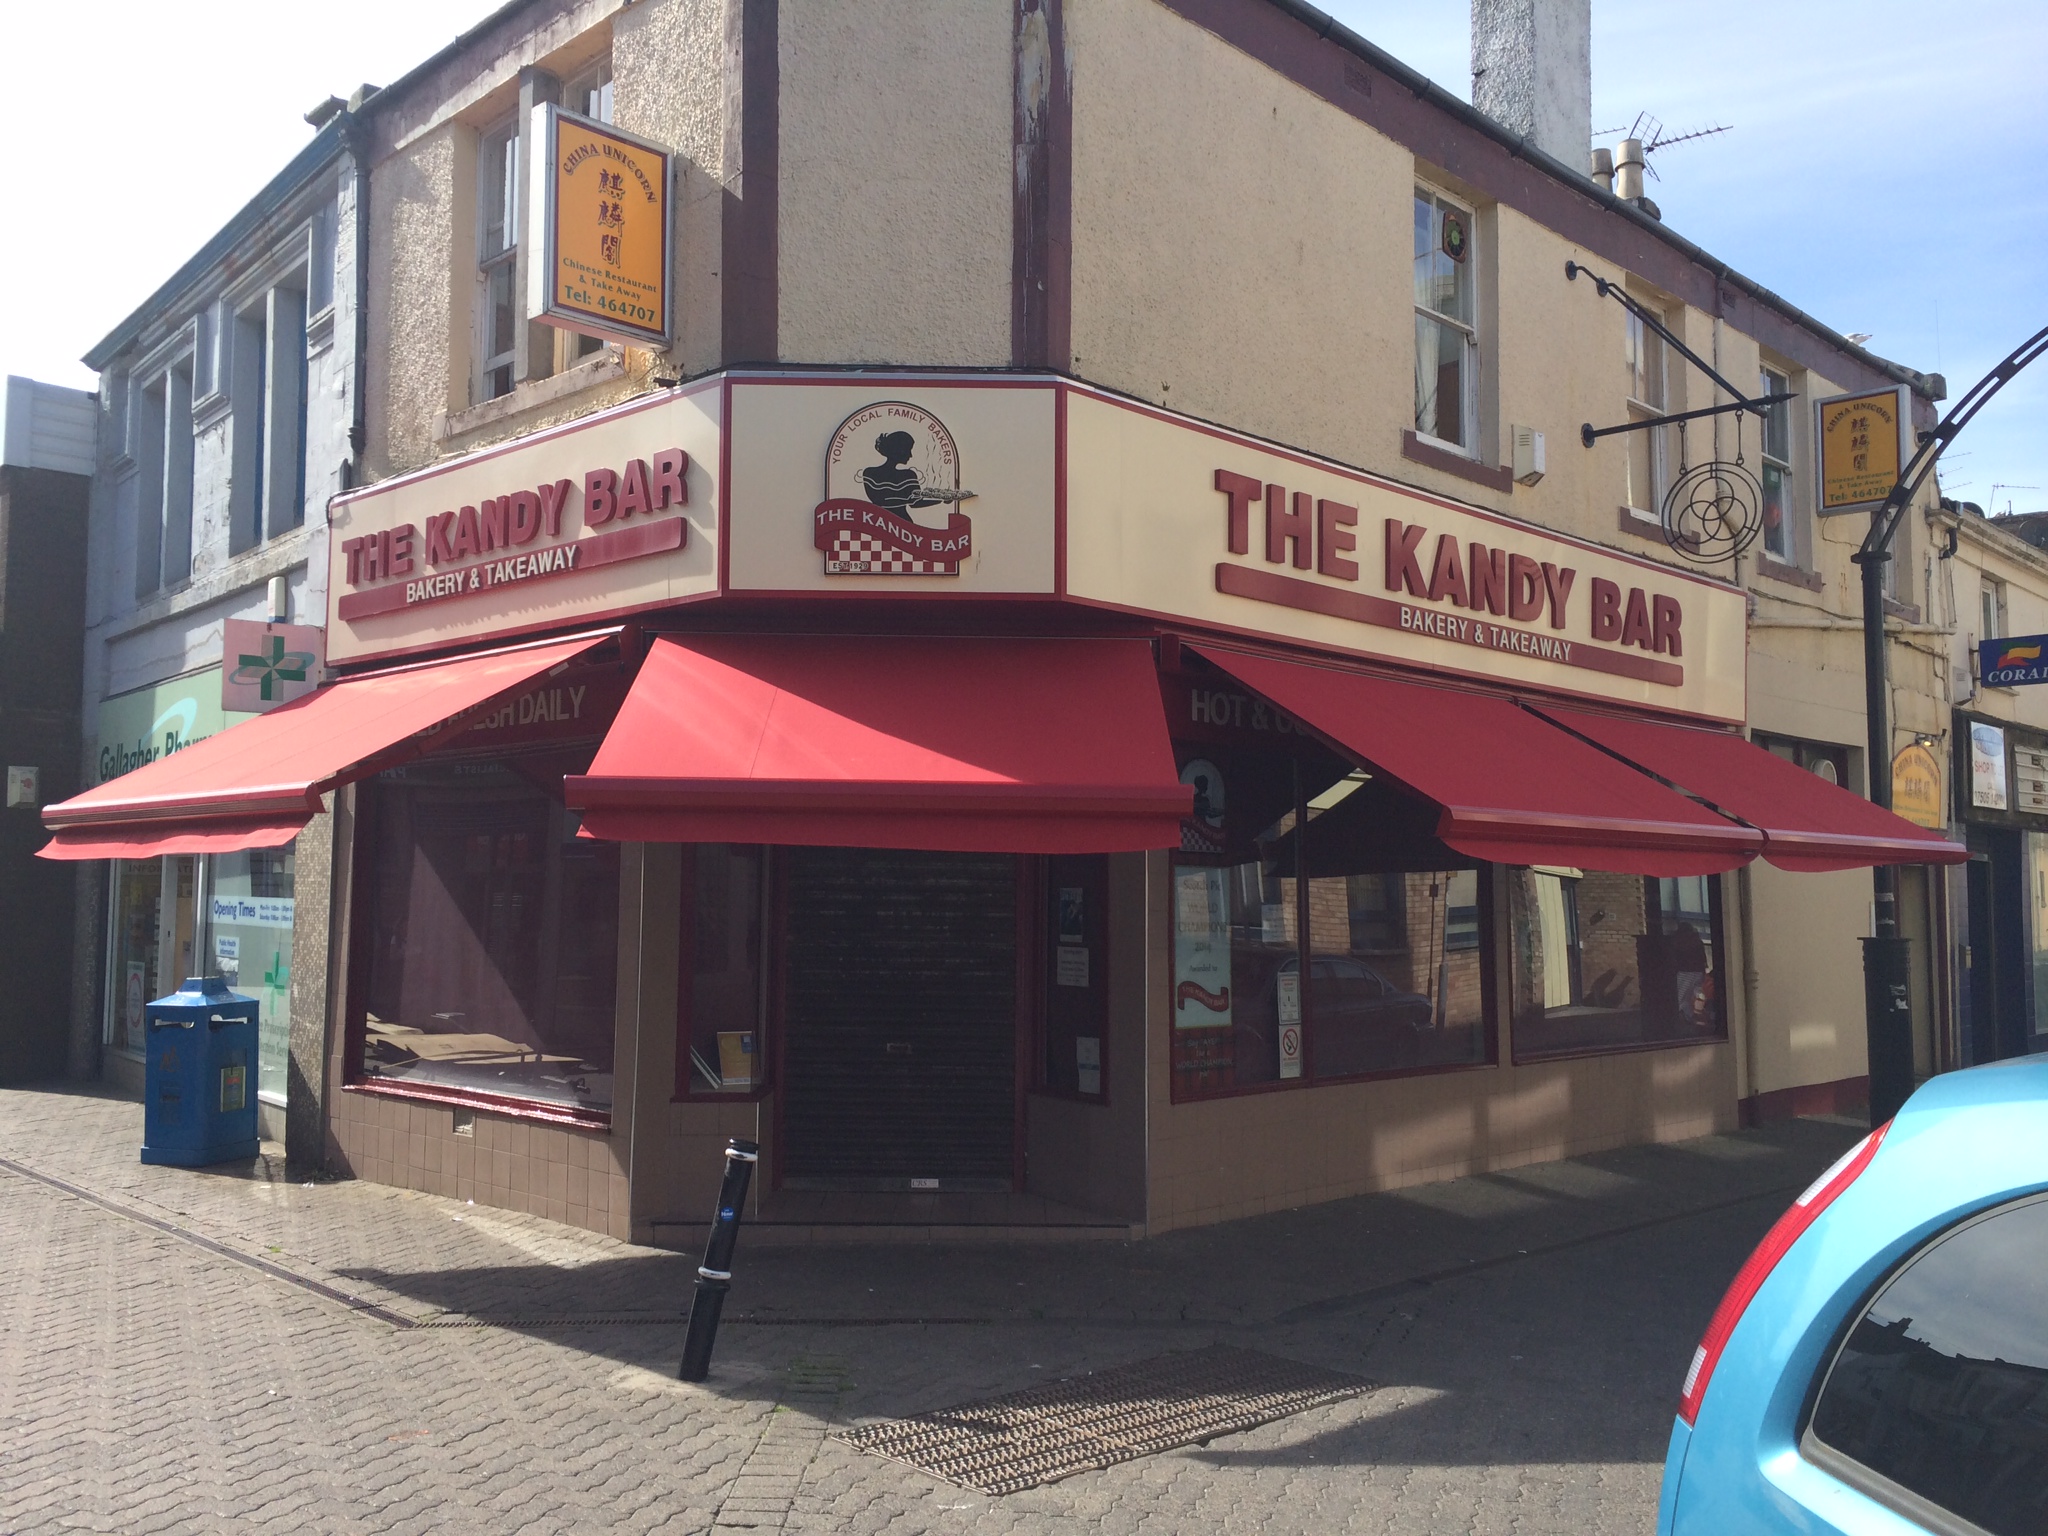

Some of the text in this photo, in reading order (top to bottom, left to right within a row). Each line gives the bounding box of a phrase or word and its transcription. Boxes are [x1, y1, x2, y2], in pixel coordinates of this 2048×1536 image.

[563, 143, 658, 204] CHINA UNICORN
[562, 257, 657, 293] Chinese Restaurant
[578, 274, 641, 301] & Take Away
[564, 285, 656, 323] Tel: 464707
[833, 407, 952, 465] YOUR LOCAL FAMILY BAKERS
[1826, 402, 1894, 433] CHINA UNICORN
[1829, 484, 1893, 502] Tel: 464707
[1865, 477, 1884, 488] Away
[342, 447, 690, 586] THE KANDY BAR
[817, 508, 969, 553] THE KANDY BAR
[406, 544, 577, 604] BAKERY & TAKEAWAY
[1215, 468, 1683, 657] THE KANDY BAR
[1401, 605, 1572, 662] BAKERY & TAKEAWAY
[518, 685, 586, 726] DAILY
[1191, 688, 1246, 728] HOT
[1251, 700, 1269, 731] &
[100, 739, 160, 781] Gallagher
[213, 899, 237, 921] Opening
[238, 901, 256, 918] Times
